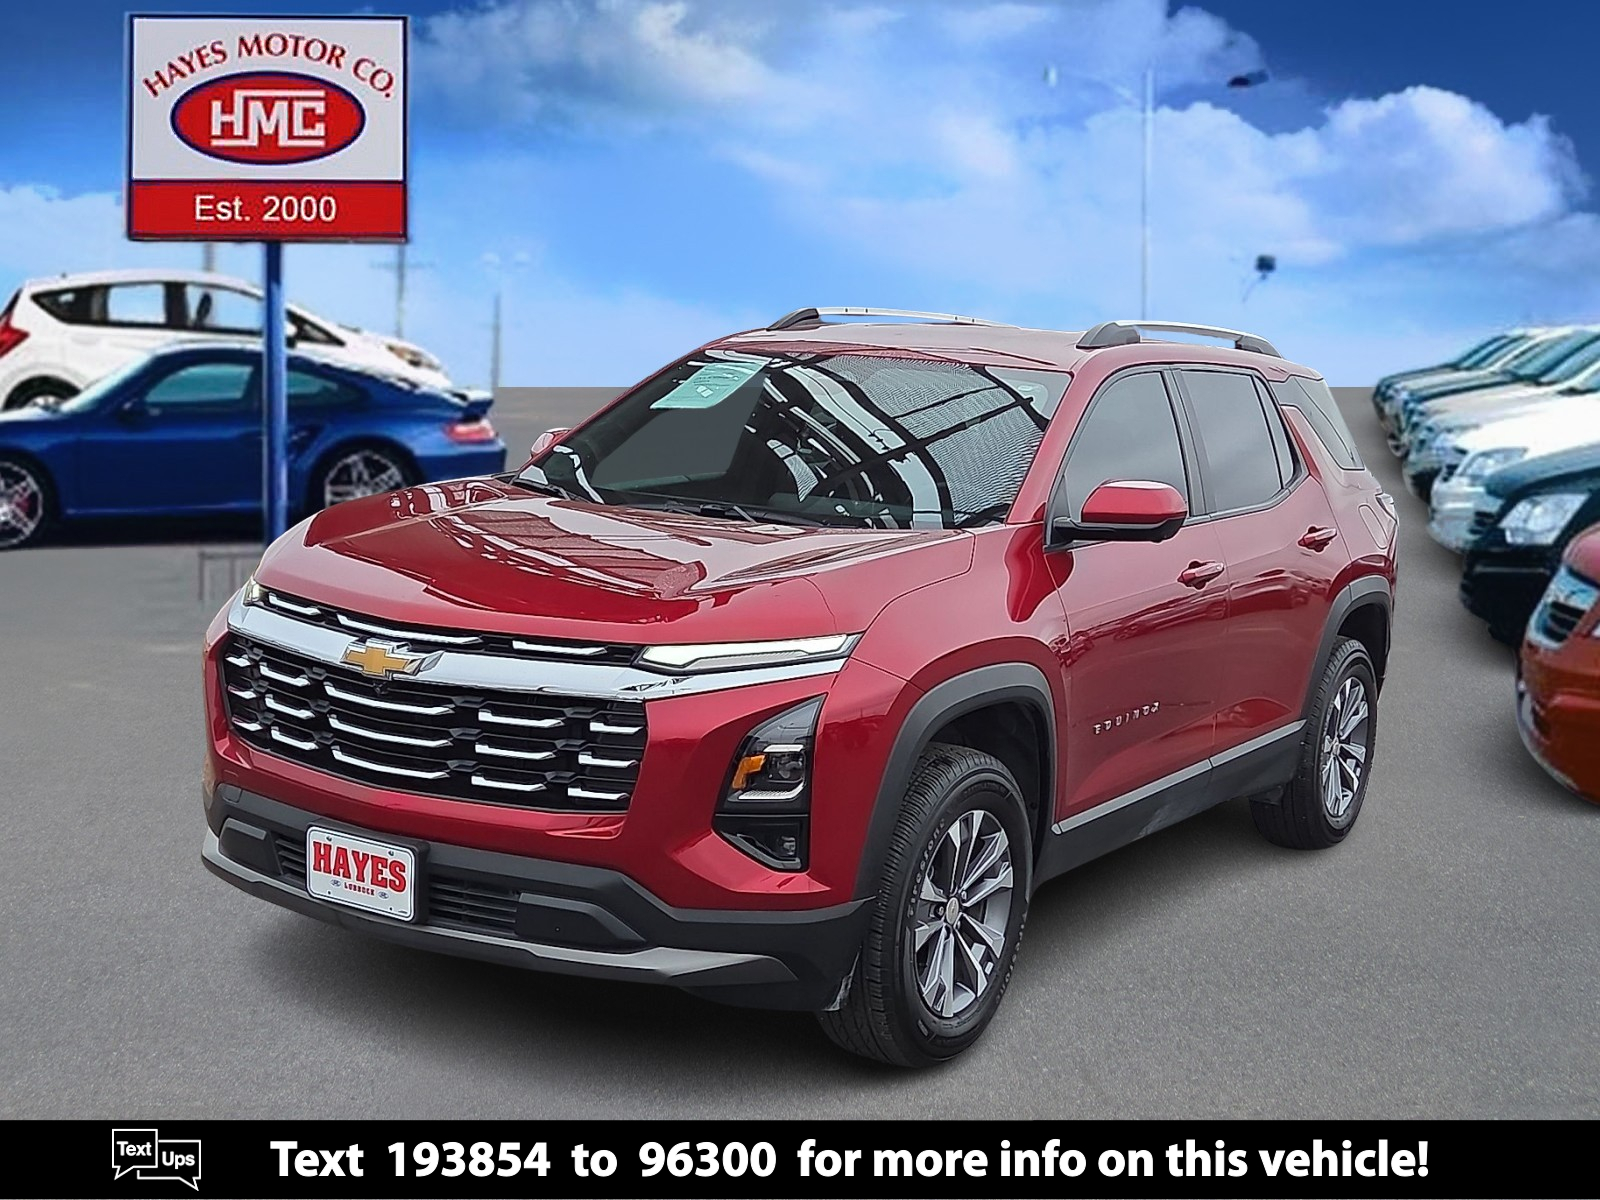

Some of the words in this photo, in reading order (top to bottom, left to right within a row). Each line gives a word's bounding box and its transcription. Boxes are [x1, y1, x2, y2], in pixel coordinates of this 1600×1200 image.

[143, 40, 228, 97] HAYES
[237, 33, 346, 69] MOTOR
[352, 57, 395, 98] CO.
[210, 88, 326, 148] HMC
[194, 194, 250, 221] Est.
[262, 195, 337, 222] 2000
[312, 840, 407, 893] HAYES
